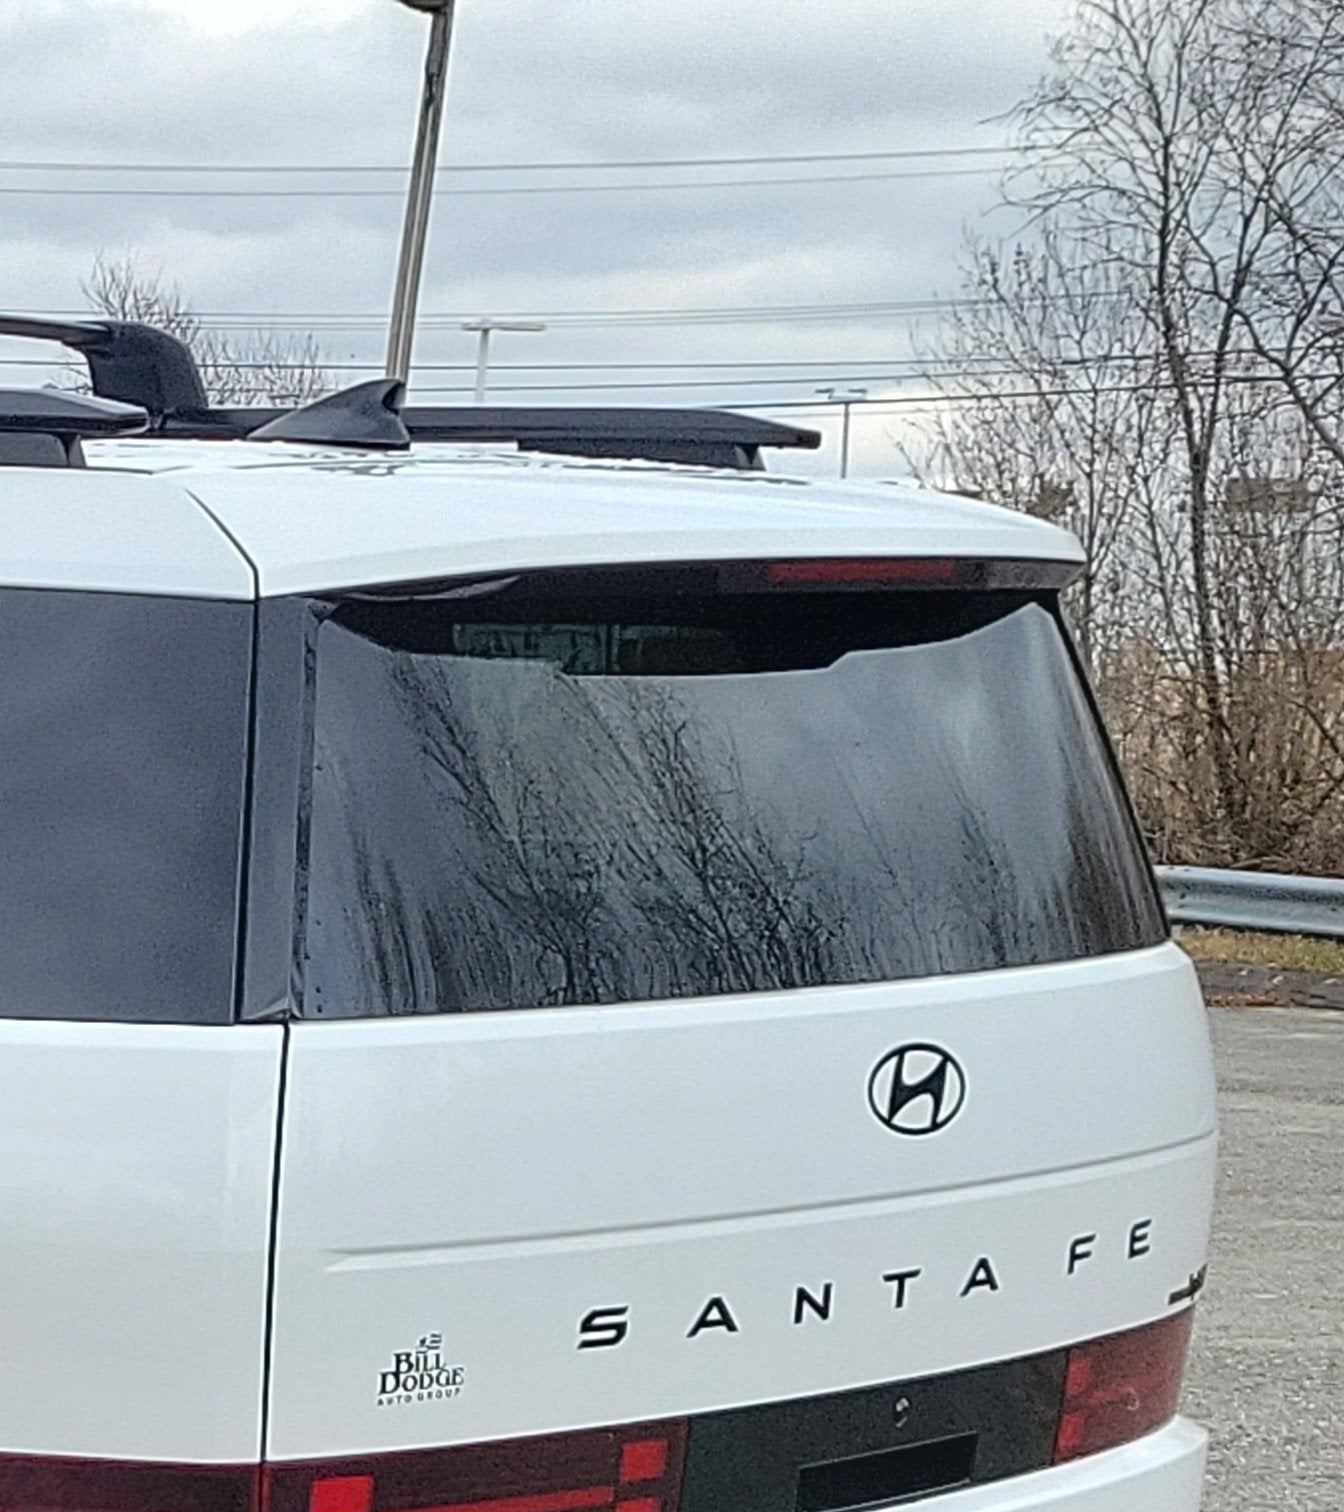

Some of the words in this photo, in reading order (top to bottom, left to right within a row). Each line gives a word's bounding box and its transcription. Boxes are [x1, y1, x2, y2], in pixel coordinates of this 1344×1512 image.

[576, 1256, 1000, 1350] SANTA
[1066, 1218, 1153, 1275] FE
[393, 1351, 446, 1375] BILL
[378, 1366, 464, 1395] DODGE
